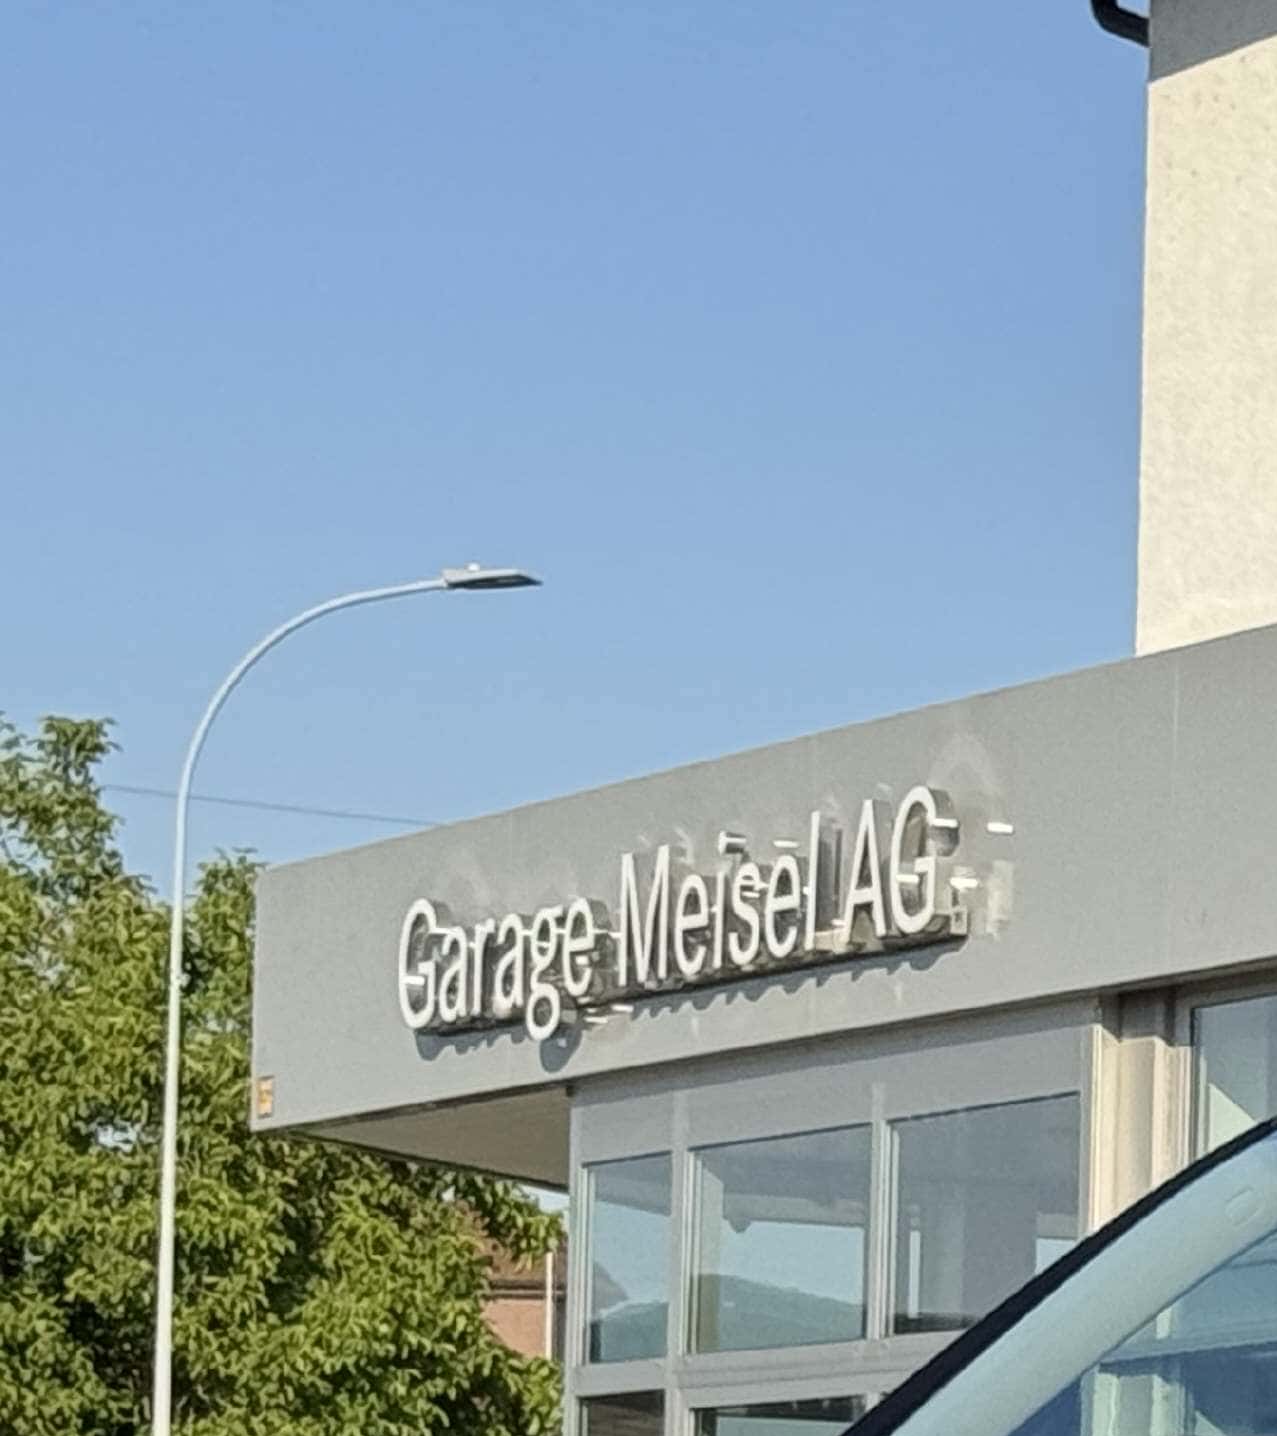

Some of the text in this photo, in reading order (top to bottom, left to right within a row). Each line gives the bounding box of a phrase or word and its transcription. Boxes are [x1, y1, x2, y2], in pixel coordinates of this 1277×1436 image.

[397, 785, 940, 1042] Garage Meisel AG
